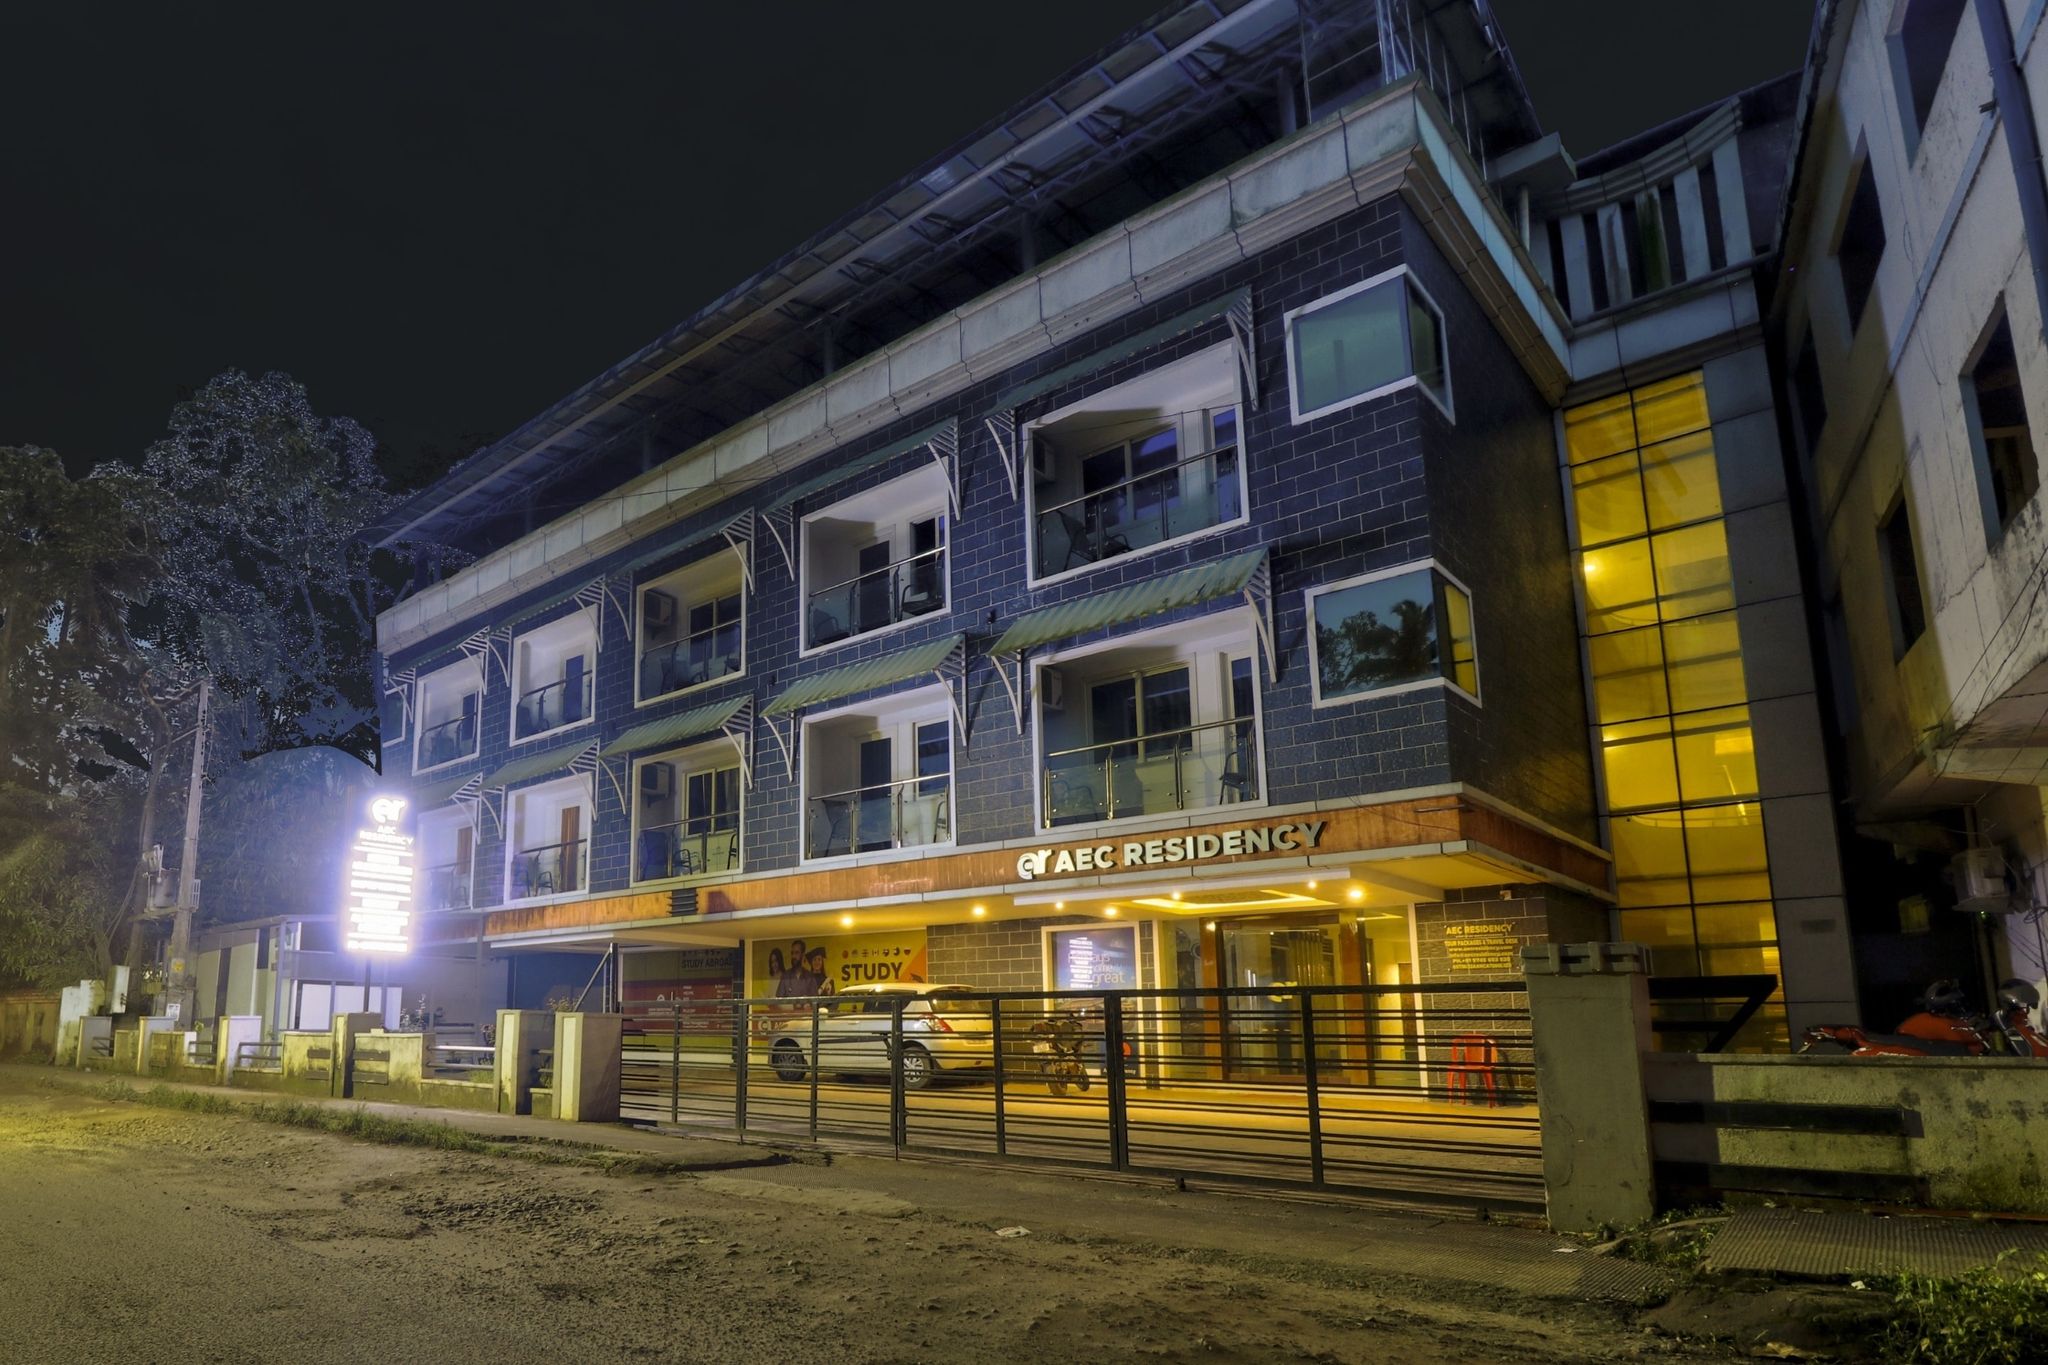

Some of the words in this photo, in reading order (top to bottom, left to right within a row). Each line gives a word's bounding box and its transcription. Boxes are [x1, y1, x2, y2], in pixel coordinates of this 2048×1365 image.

[1053, 845, 1117, 873] AEC
[1124, 820, 1328, 866] RESIDENCY
[1446, 926, 1463, 934] AEC
[1464, 924, 1513, 933] RESIDENCY
[681, 958, 704, 969] STUDY
[841, 961, 903, 982] STUDY
